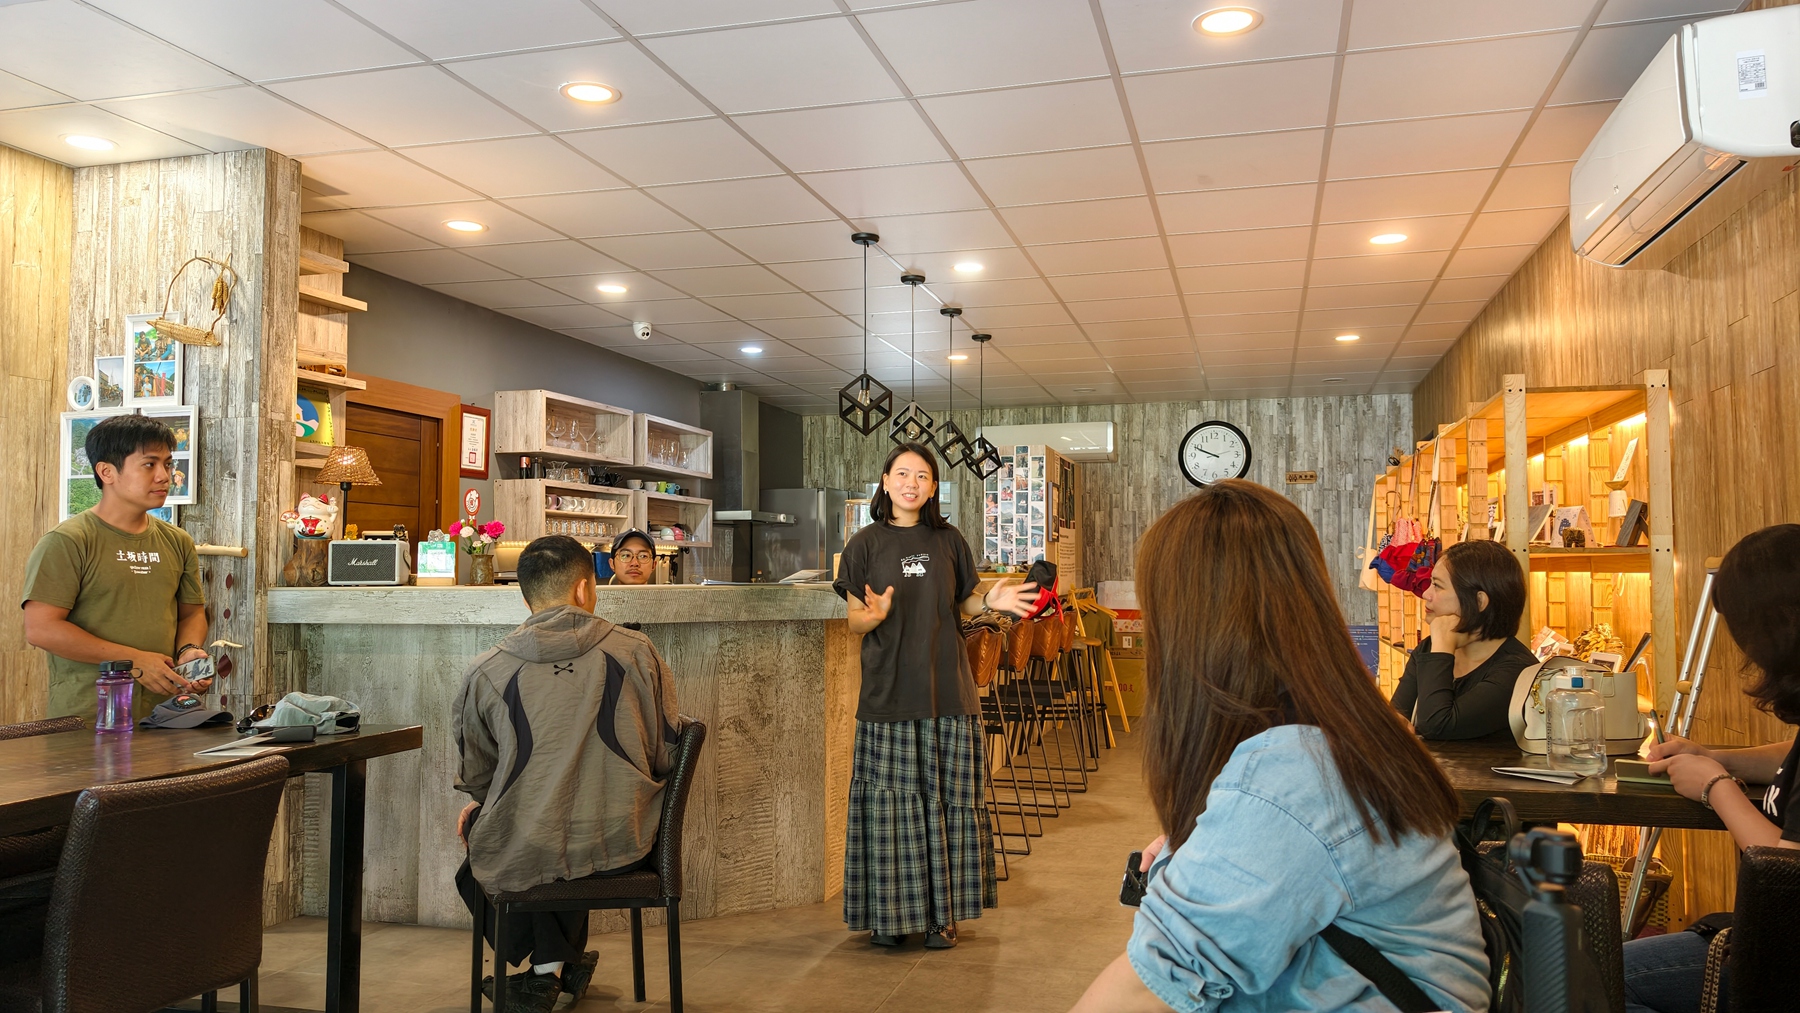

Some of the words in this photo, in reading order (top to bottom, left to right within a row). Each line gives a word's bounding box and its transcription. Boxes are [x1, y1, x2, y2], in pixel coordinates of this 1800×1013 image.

[1201, 435, 1208, 443] 11
[1193, 443, 1203, 451] 10
[1229, 440, 1235, 448] 2
[1190, 452, 1197, 460] 9
[1194, 462, 1200, 470] 8
[1211, 471, 1218, 479] 6
[1223, 468, 1229, 477] 5
[116, 550, 161, 564] 土坂時間
[347, 557, 379, 566] Marshall
